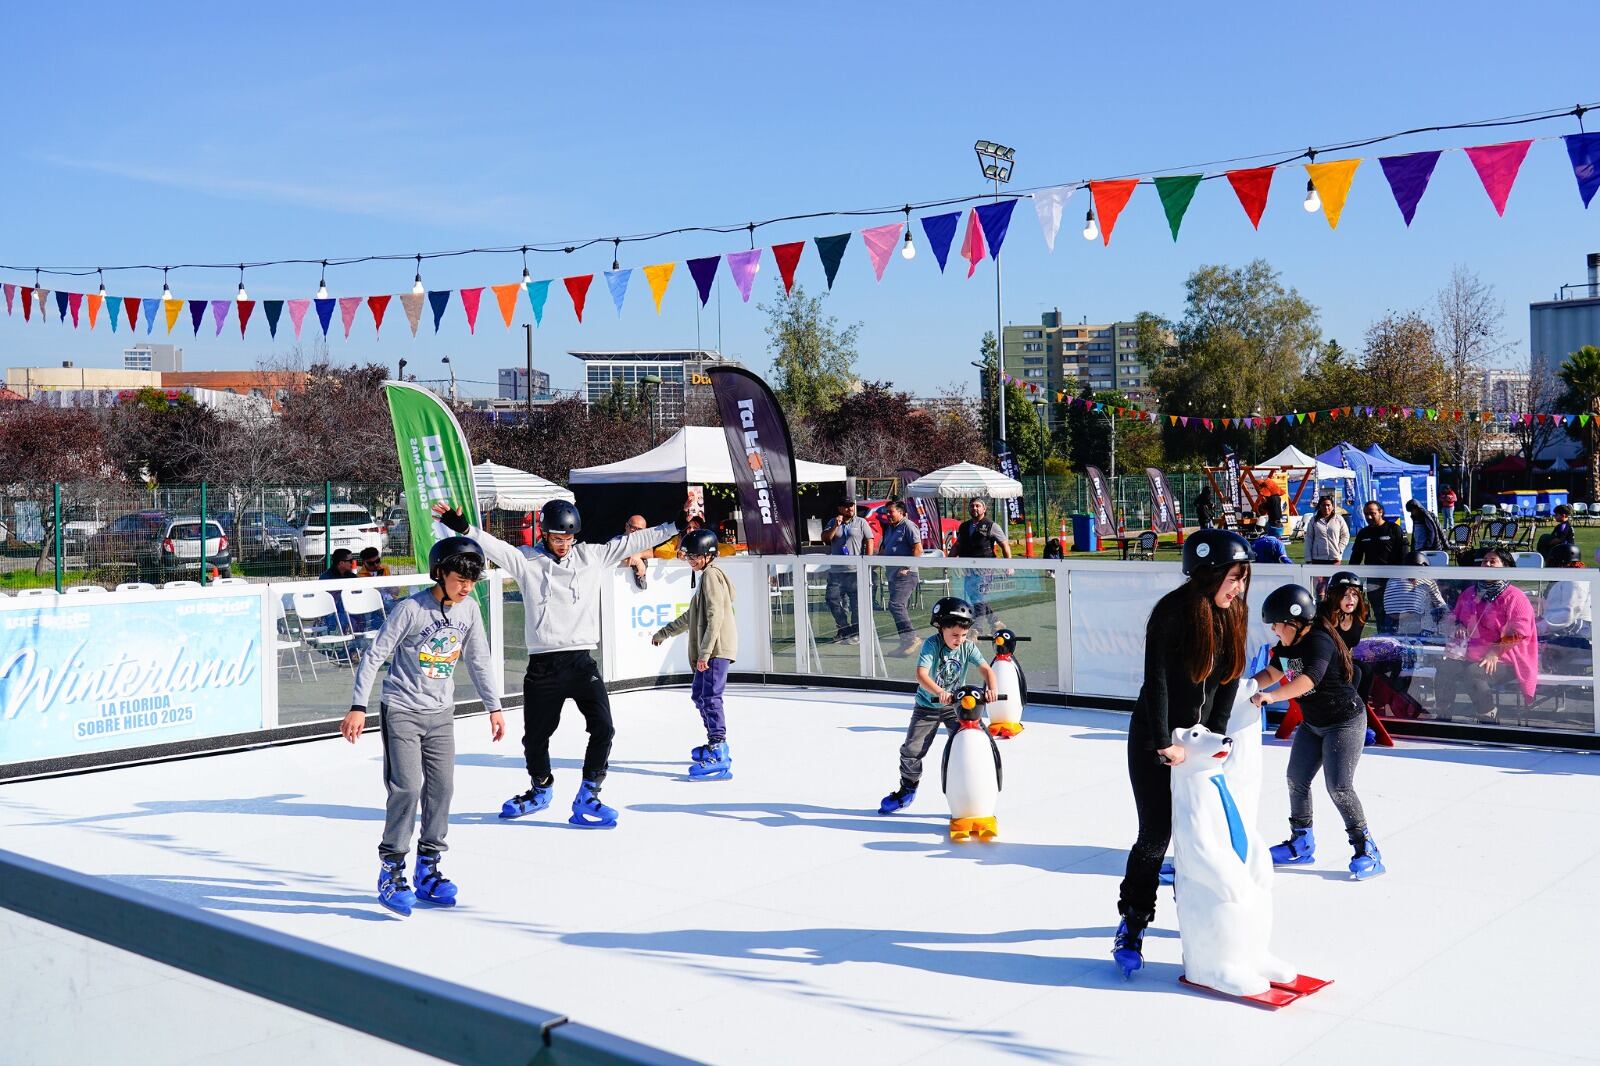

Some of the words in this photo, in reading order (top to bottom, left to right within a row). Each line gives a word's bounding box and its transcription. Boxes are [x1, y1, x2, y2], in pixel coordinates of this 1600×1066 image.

[0, 639, 255, 719] Winterland
[101, 701, 118, 717] LA
[120, 695, 171, 714] FLORIDA
[77, 718, 121, 737] SOBRE
[123, 712, 158, 730] HIELO
[161, 707, 193, 724] 2025
